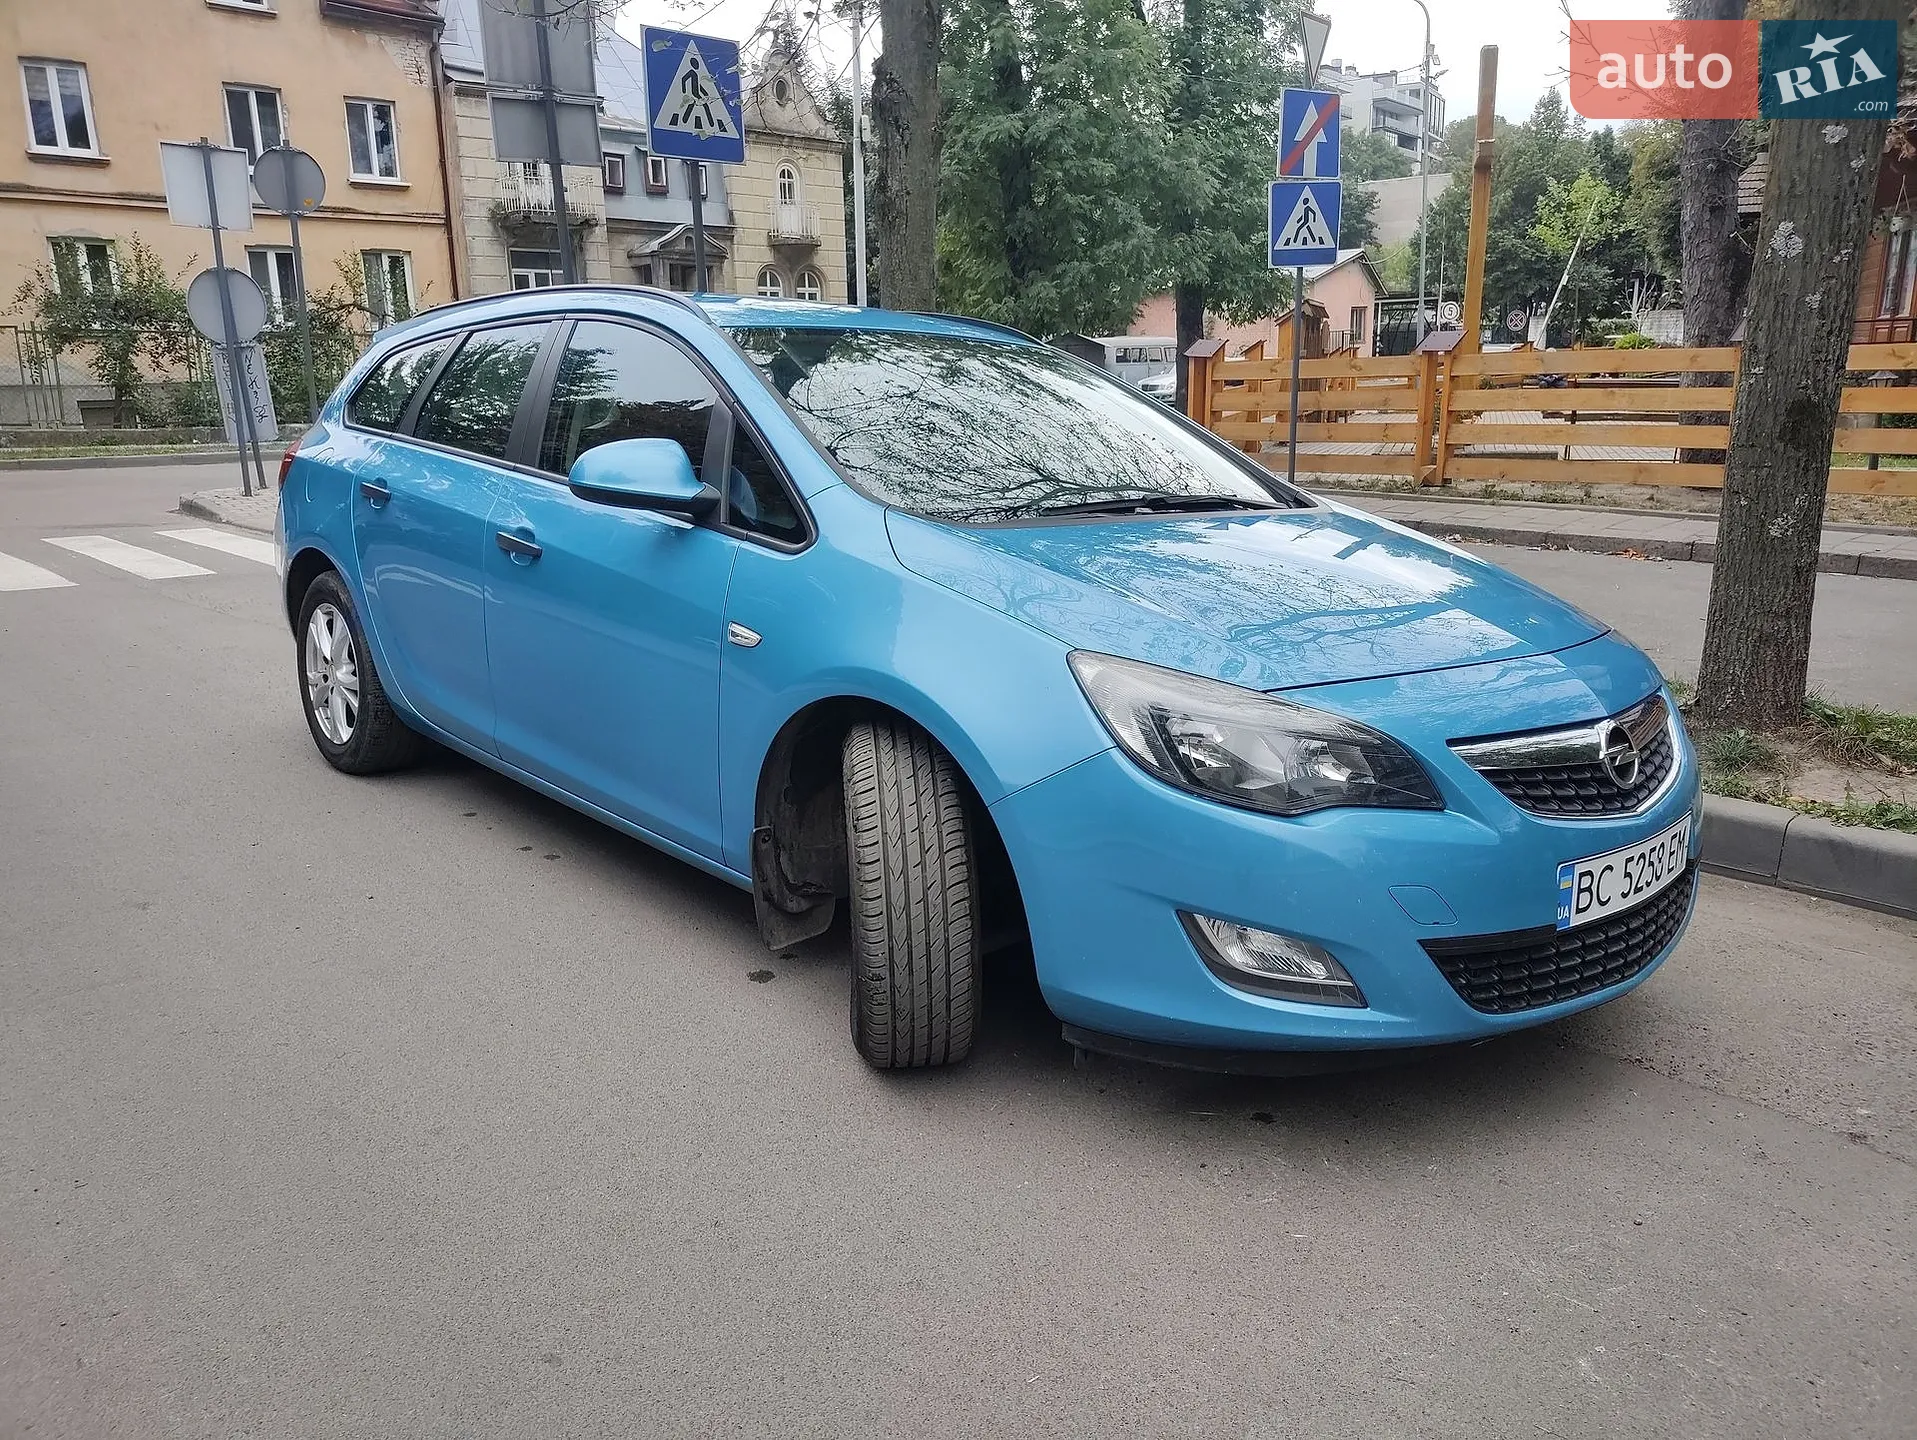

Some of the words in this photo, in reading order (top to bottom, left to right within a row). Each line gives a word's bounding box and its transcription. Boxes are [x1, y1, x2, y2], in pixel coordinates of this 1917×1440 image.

[1575, 864, 1615, 915] BC
[1620, 841, 1665, 899] 5258
[1667, 825, 1687, 875] EM
[1557, 906, 1570, 920] UA
